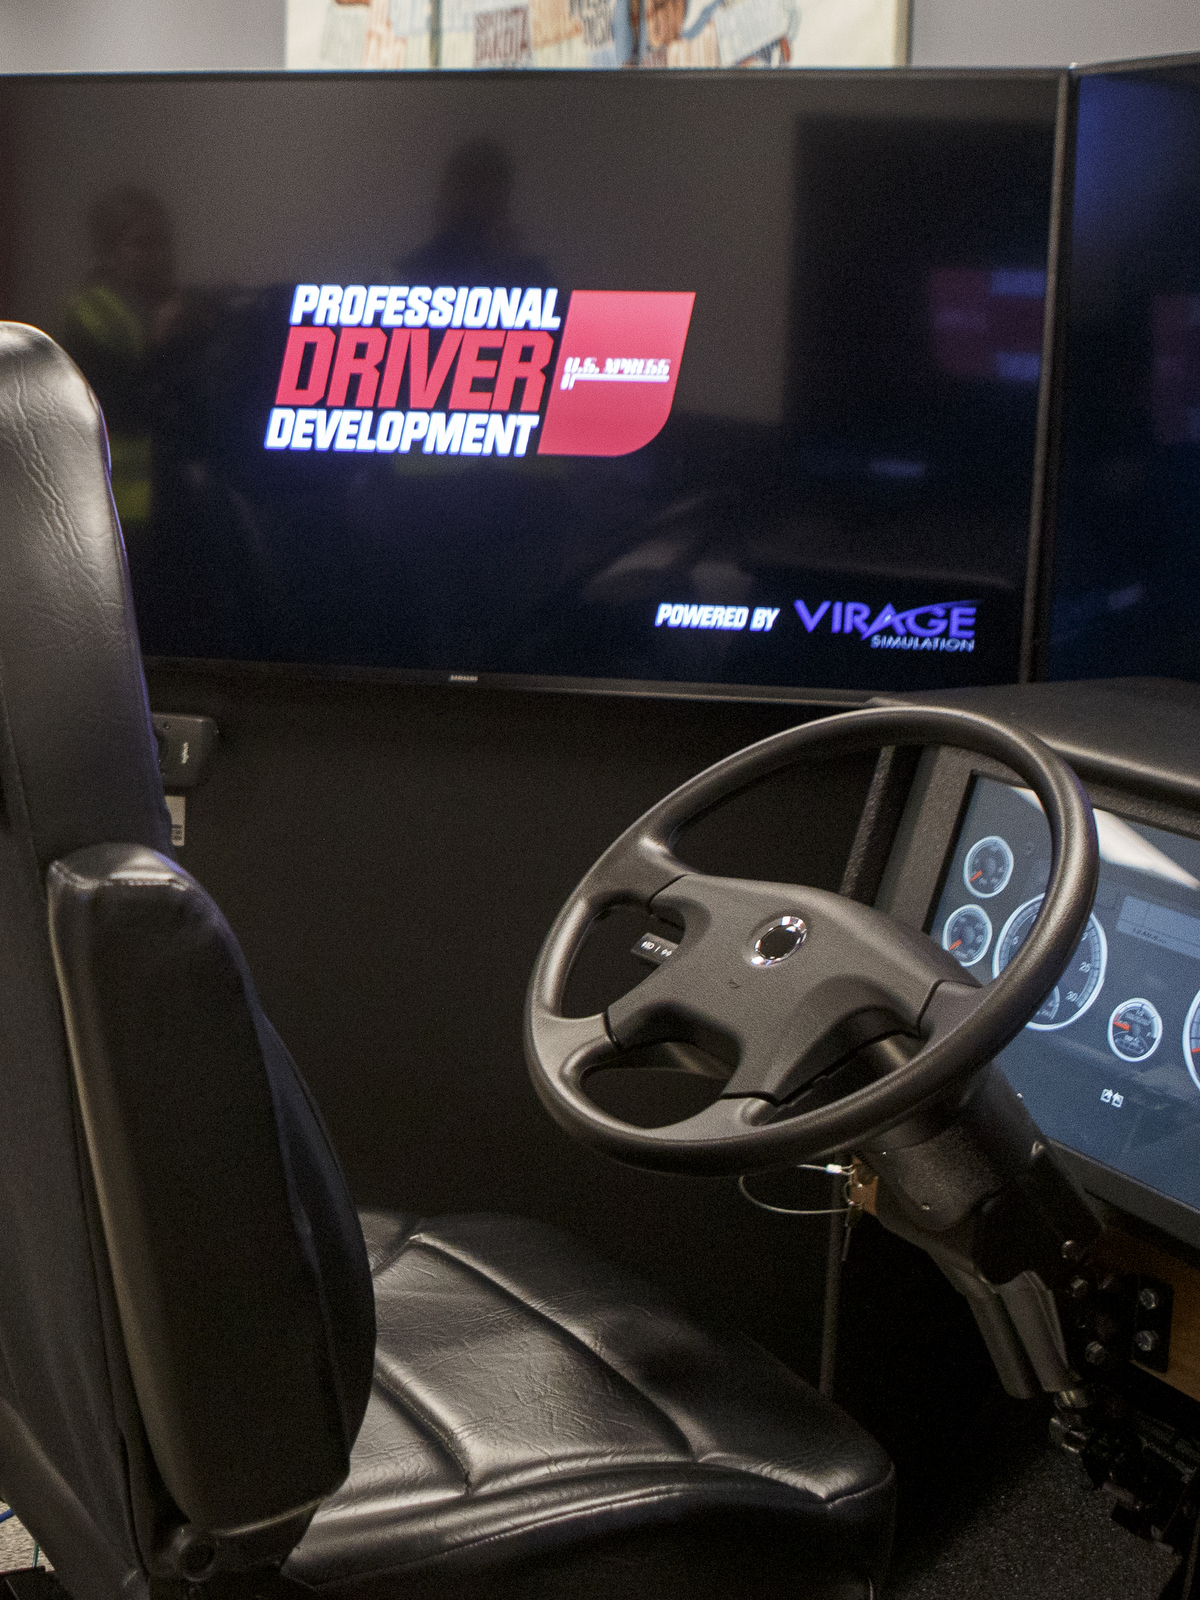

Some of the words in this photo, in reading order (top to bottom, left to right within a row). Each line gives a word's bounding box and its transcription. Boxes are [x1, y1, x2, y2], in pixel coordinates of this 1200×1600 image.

[289, 284, 561, 331] PROFESSIONAL
[275, 327, 555, 412] DRIVER
[264, 407, 540, 457] DEVELOPMENT
[654, 603, 749, 631] POWERED
[750, 607, 780, 632] BY
[794, 599, 977, 640] VIRAGE
[870, 635, 975, 653] SIMULATION
